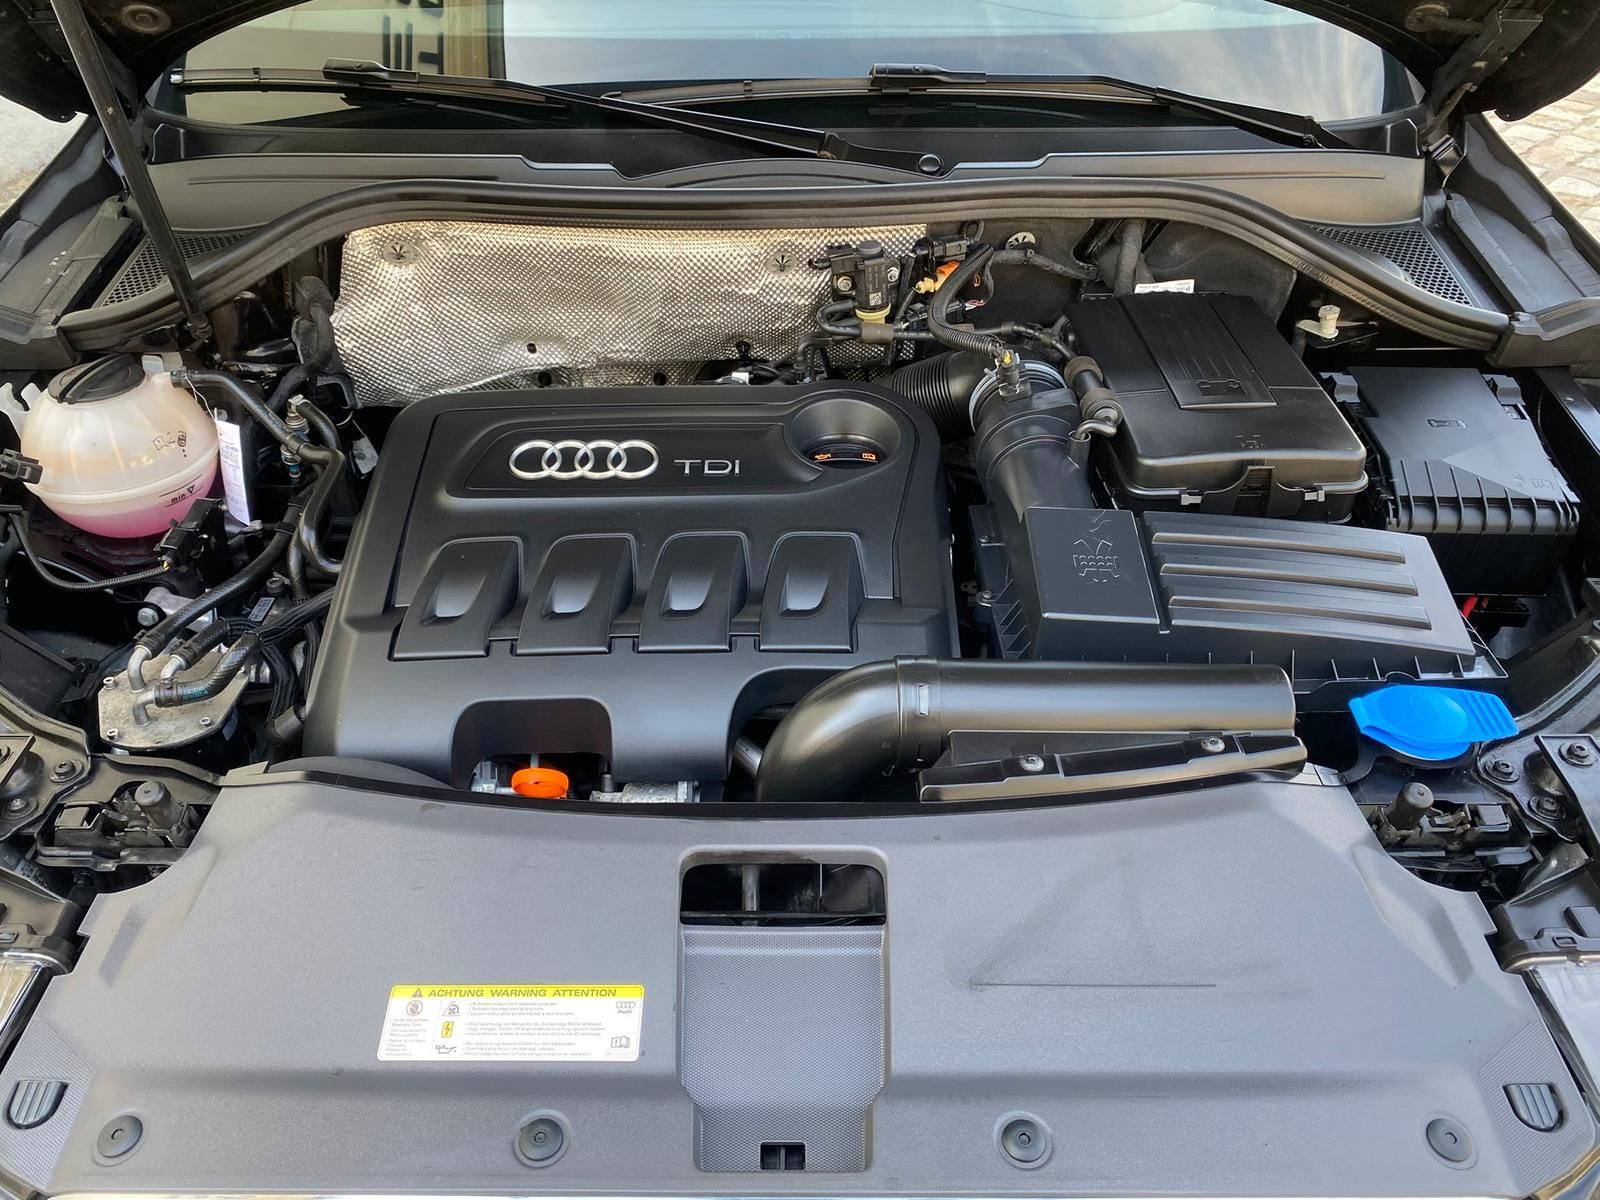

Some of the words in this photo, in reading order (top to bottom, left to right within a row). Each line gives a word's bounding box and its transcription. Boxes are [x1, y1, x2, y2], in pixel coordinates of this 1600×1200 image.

[673, 459, 740, 475] TDI
[171, 493, 186, 504] min
[428, 987, 484, 997] ACHTUNG
[490, 987, 547, 997] WARNING
[553, 987, 617, 997] ATTENTION
